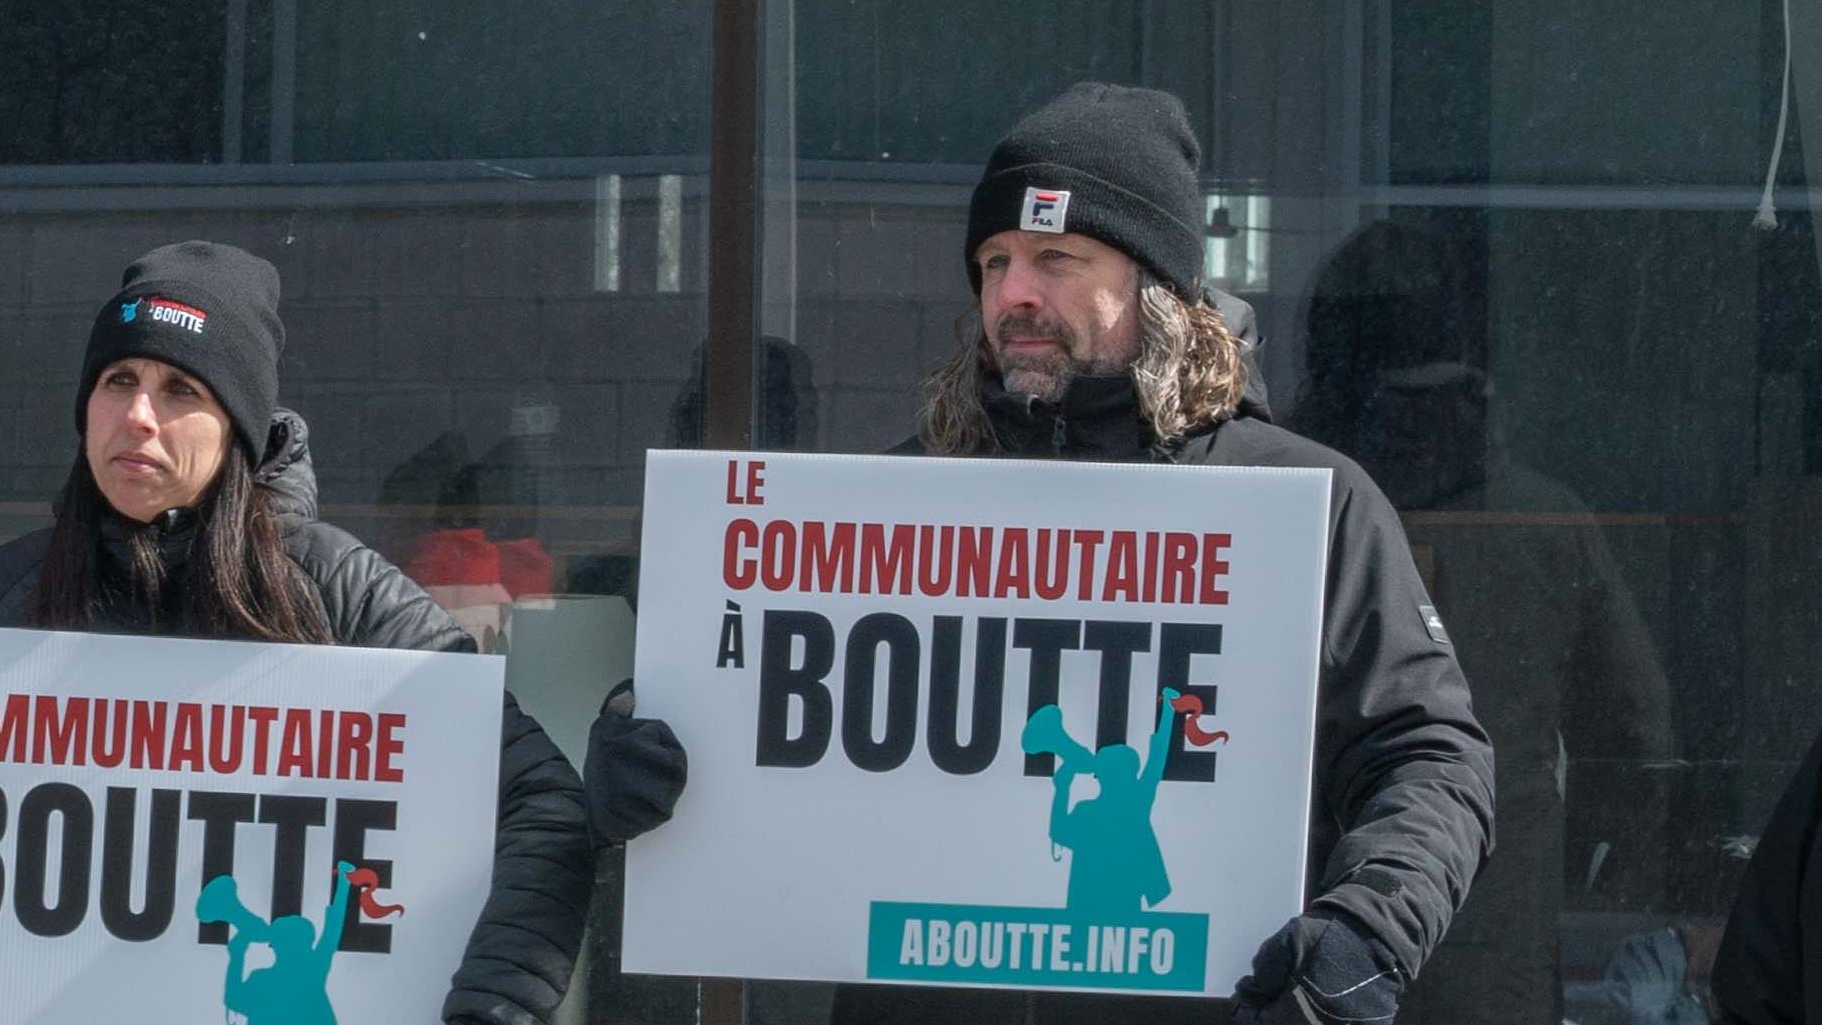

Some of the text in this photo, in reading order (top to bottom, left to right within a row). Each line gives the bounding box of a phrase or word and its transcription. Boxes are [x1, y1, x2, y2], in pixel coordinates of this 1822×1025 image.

[1032, 218, 1053, 226] FILA
[153, 306, 205, 333] BOUTTE
[726, 460, 765, 506] LE
[722, 517, 1232, 606] COMMUNAUTAIRE
[716, 599, 1224, 784] À BOUTTE
[899, 918, 1176, 976] ABOUTTE.INFO
